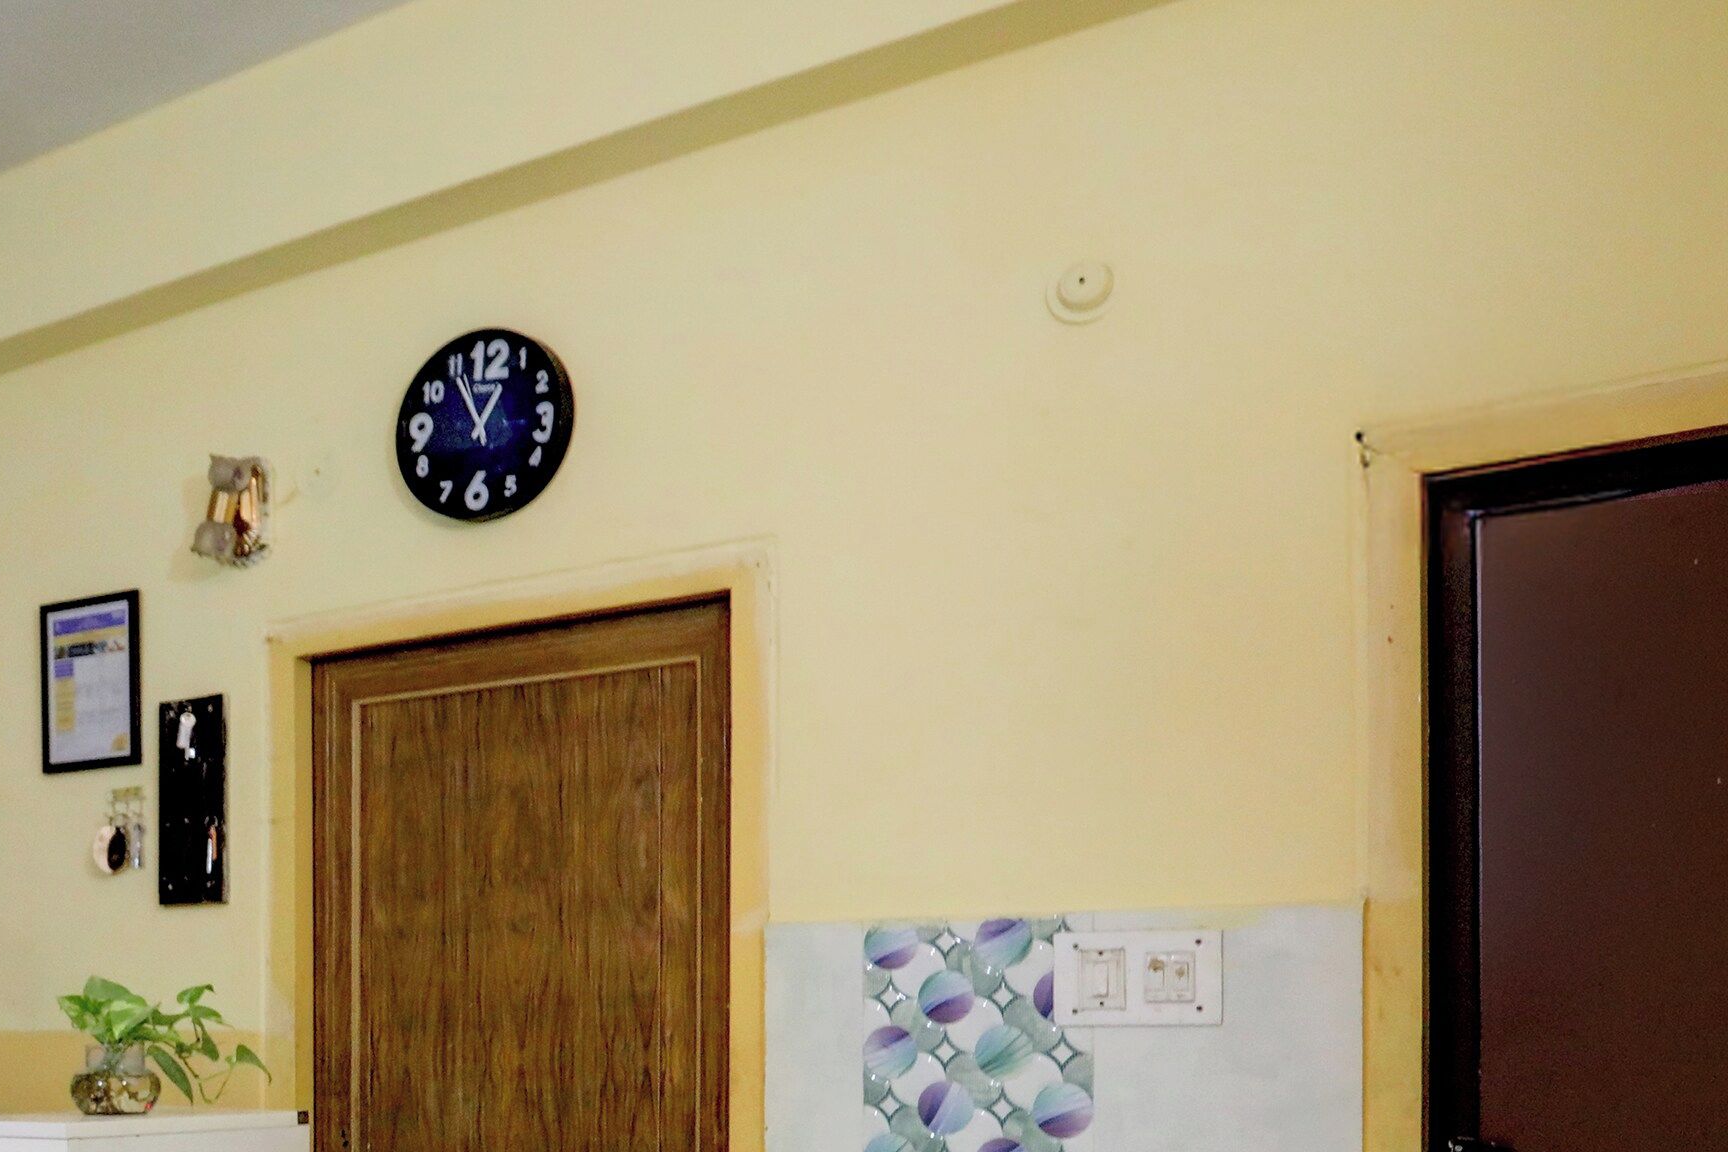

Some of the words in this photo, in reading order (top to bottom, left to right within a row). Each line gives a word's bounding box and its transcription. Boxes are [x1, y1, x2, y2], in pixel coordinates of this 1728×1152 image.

[448, 353, 463, 379] 11
[470, 338, 510, 381] 12
[519, 346, 527, 370] 1
[423, 380, 445, 405] 10
[535, 369, 549, 394] 2
[409, 412, 434, 453] 9
[532, 401, 554, 444] 3
[416, 454, 429, 478] 8
[439, 480, 453, 504] 7
[464, 470, 489, 511] 6
[504, 474, 517, 497] 5
